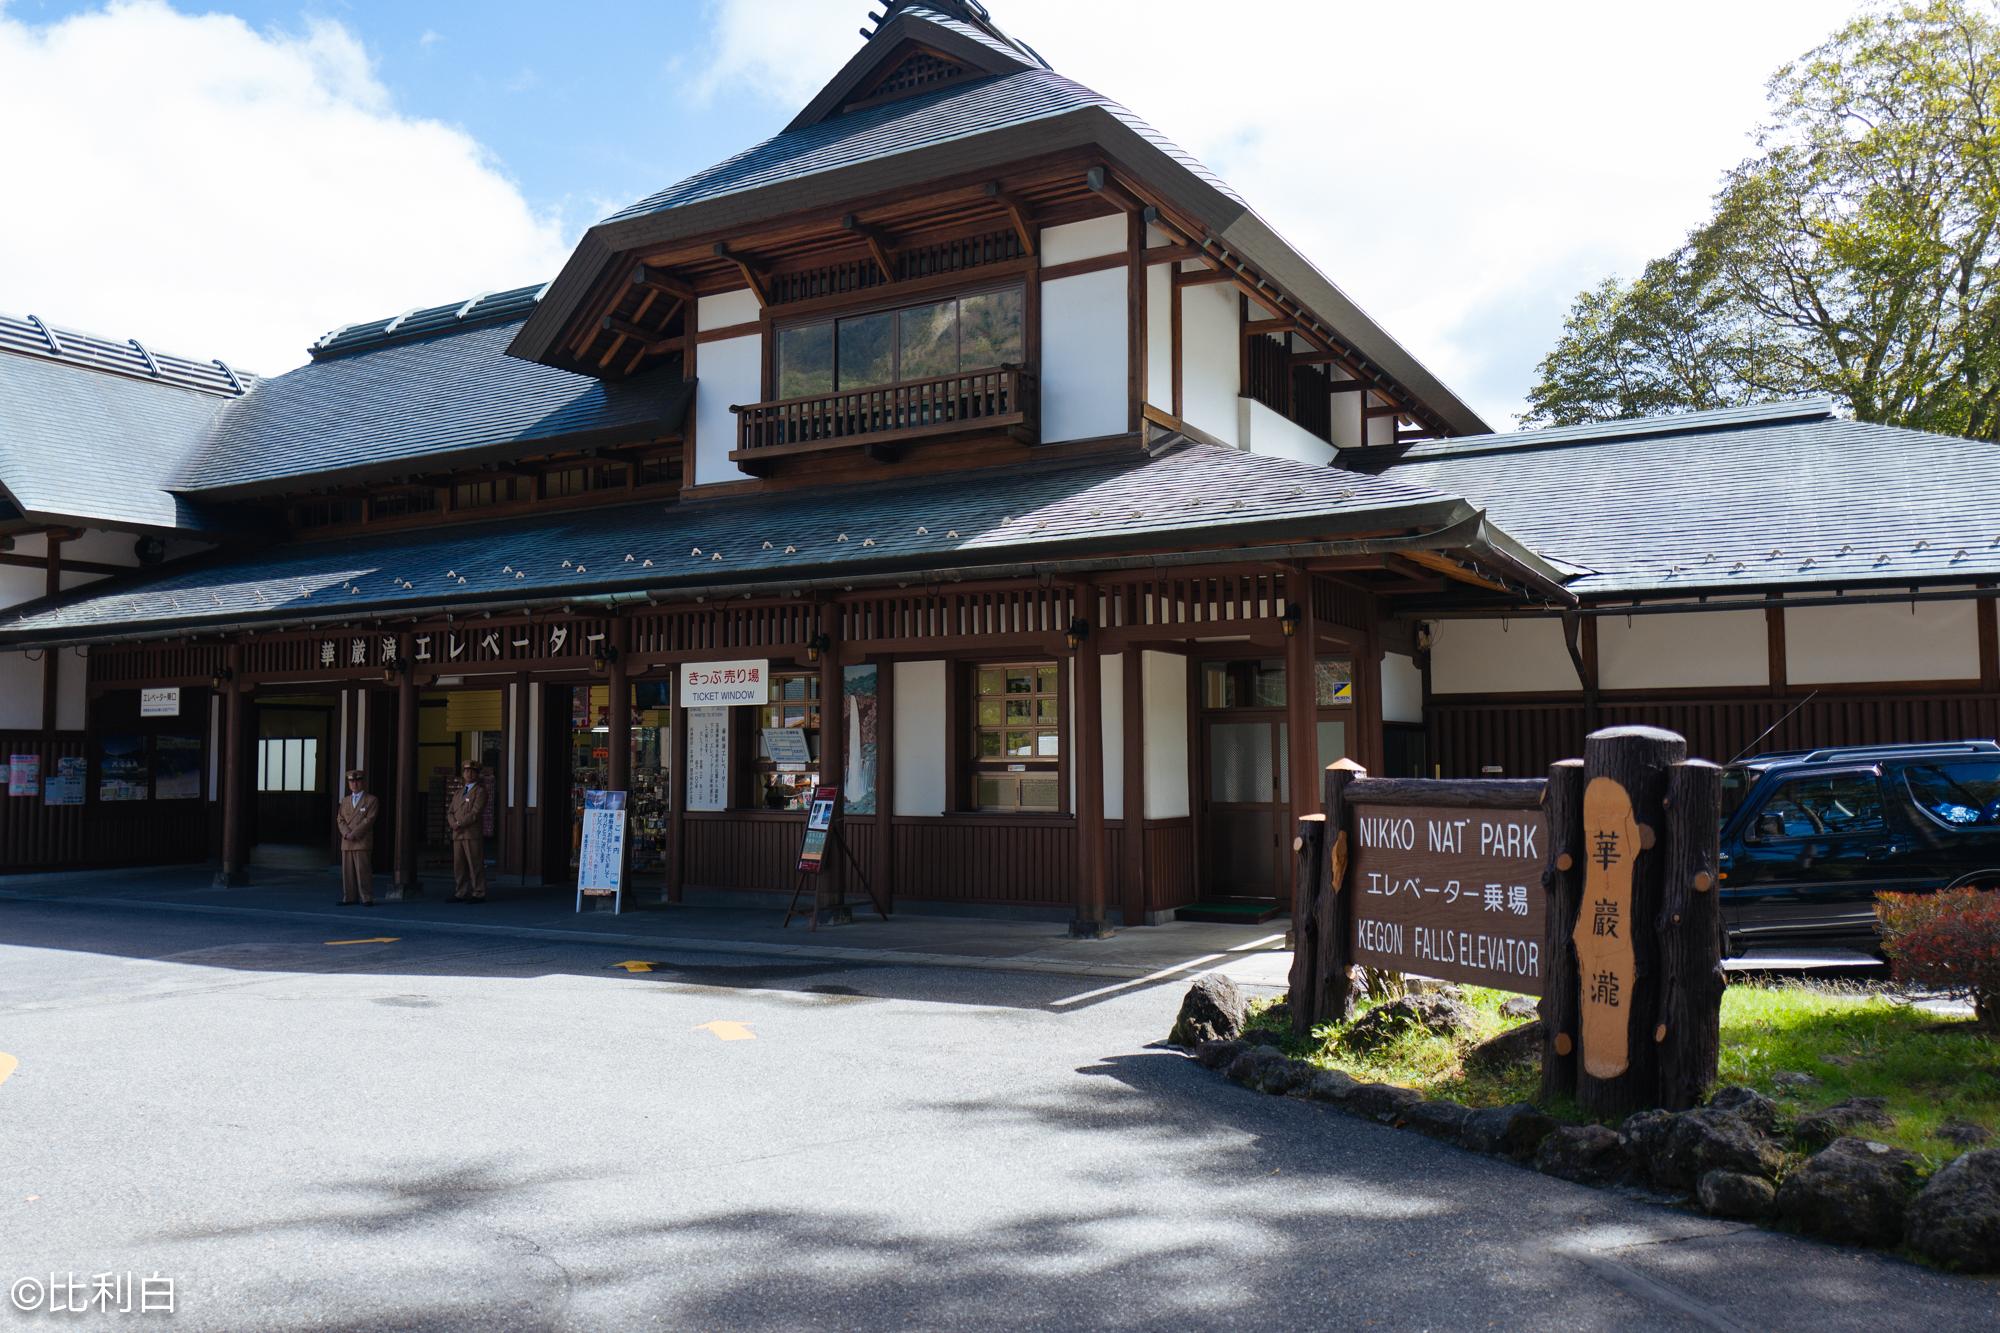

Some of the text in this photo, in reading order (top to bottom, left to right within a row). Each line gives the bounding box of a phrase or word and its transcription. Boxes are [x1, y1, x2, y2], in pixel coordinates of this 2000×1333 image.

[688, 668, 760, 686] きっぷ売り場
[692, 690, 755, 701] TICKET WINDOW
[1359, 817, 1415, 851] NIKKO
[1480, 822, 1538, 860] PARK
[1367, 872, 1529, 917] エレベーター乗場
[1358, 919, 1539, 978] KEGON FALLS ELEVATOR
